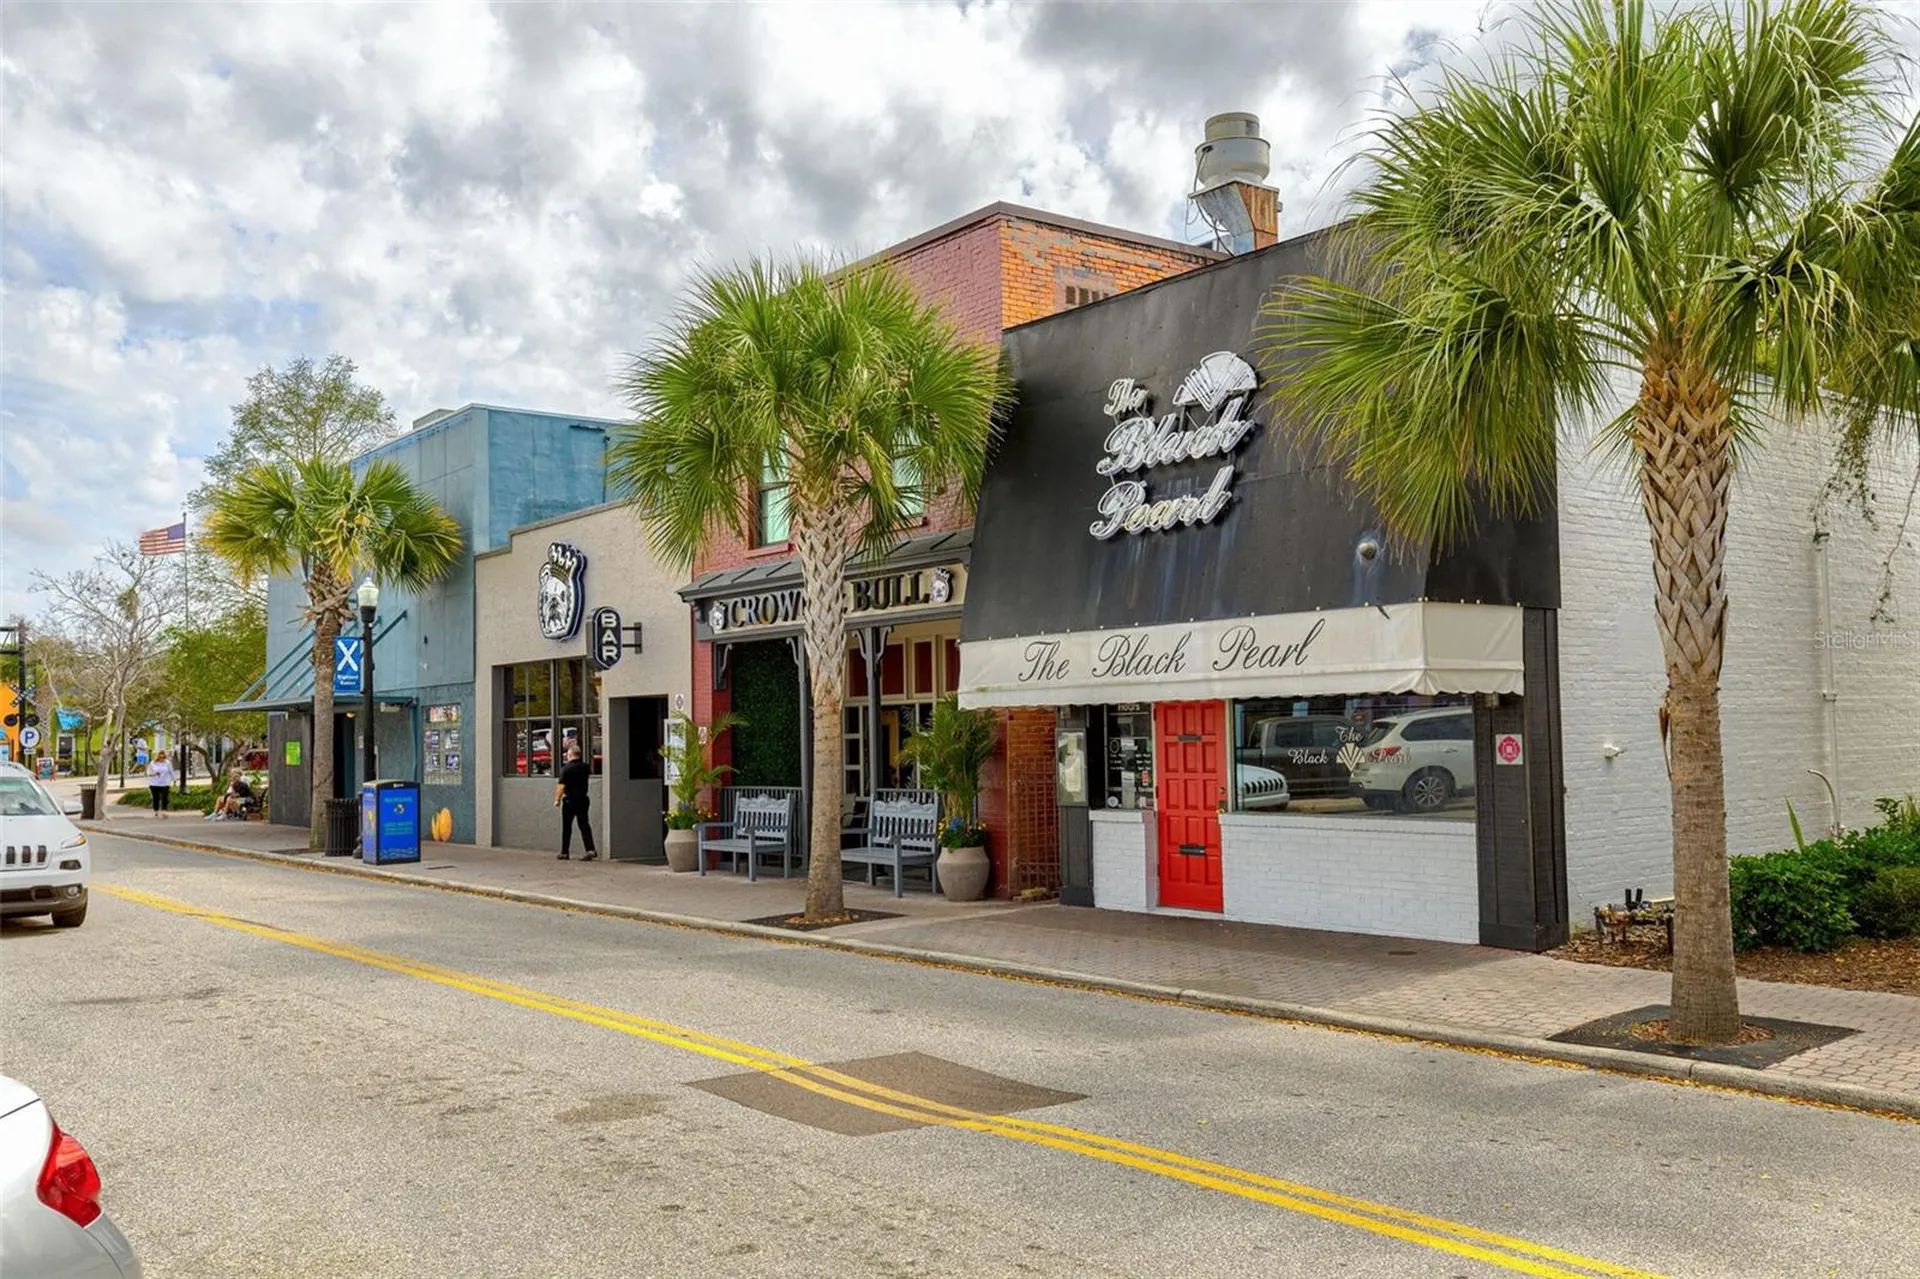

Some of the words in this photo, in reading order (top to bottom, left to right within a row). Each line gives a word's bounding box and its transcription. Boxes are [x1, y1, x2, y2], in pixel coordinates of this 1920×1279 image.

[1103, 378, 1149, 416] The
[1096, 397, 1255, 476] Black
[1089, 465, 1234, 540] Pearl
[852, 571, 930, 612] BULL
[601, 612, 619, 661] BAR
[1018, 640, 1070, 682] The
[1091, 631, 1192, 678] Black
[1212, 618, 1326, 671] Pearl
[24, 731, 35, 744] P
[1335, 725, 1364, 742] The
[1288, 748, 1329, 764] Black
